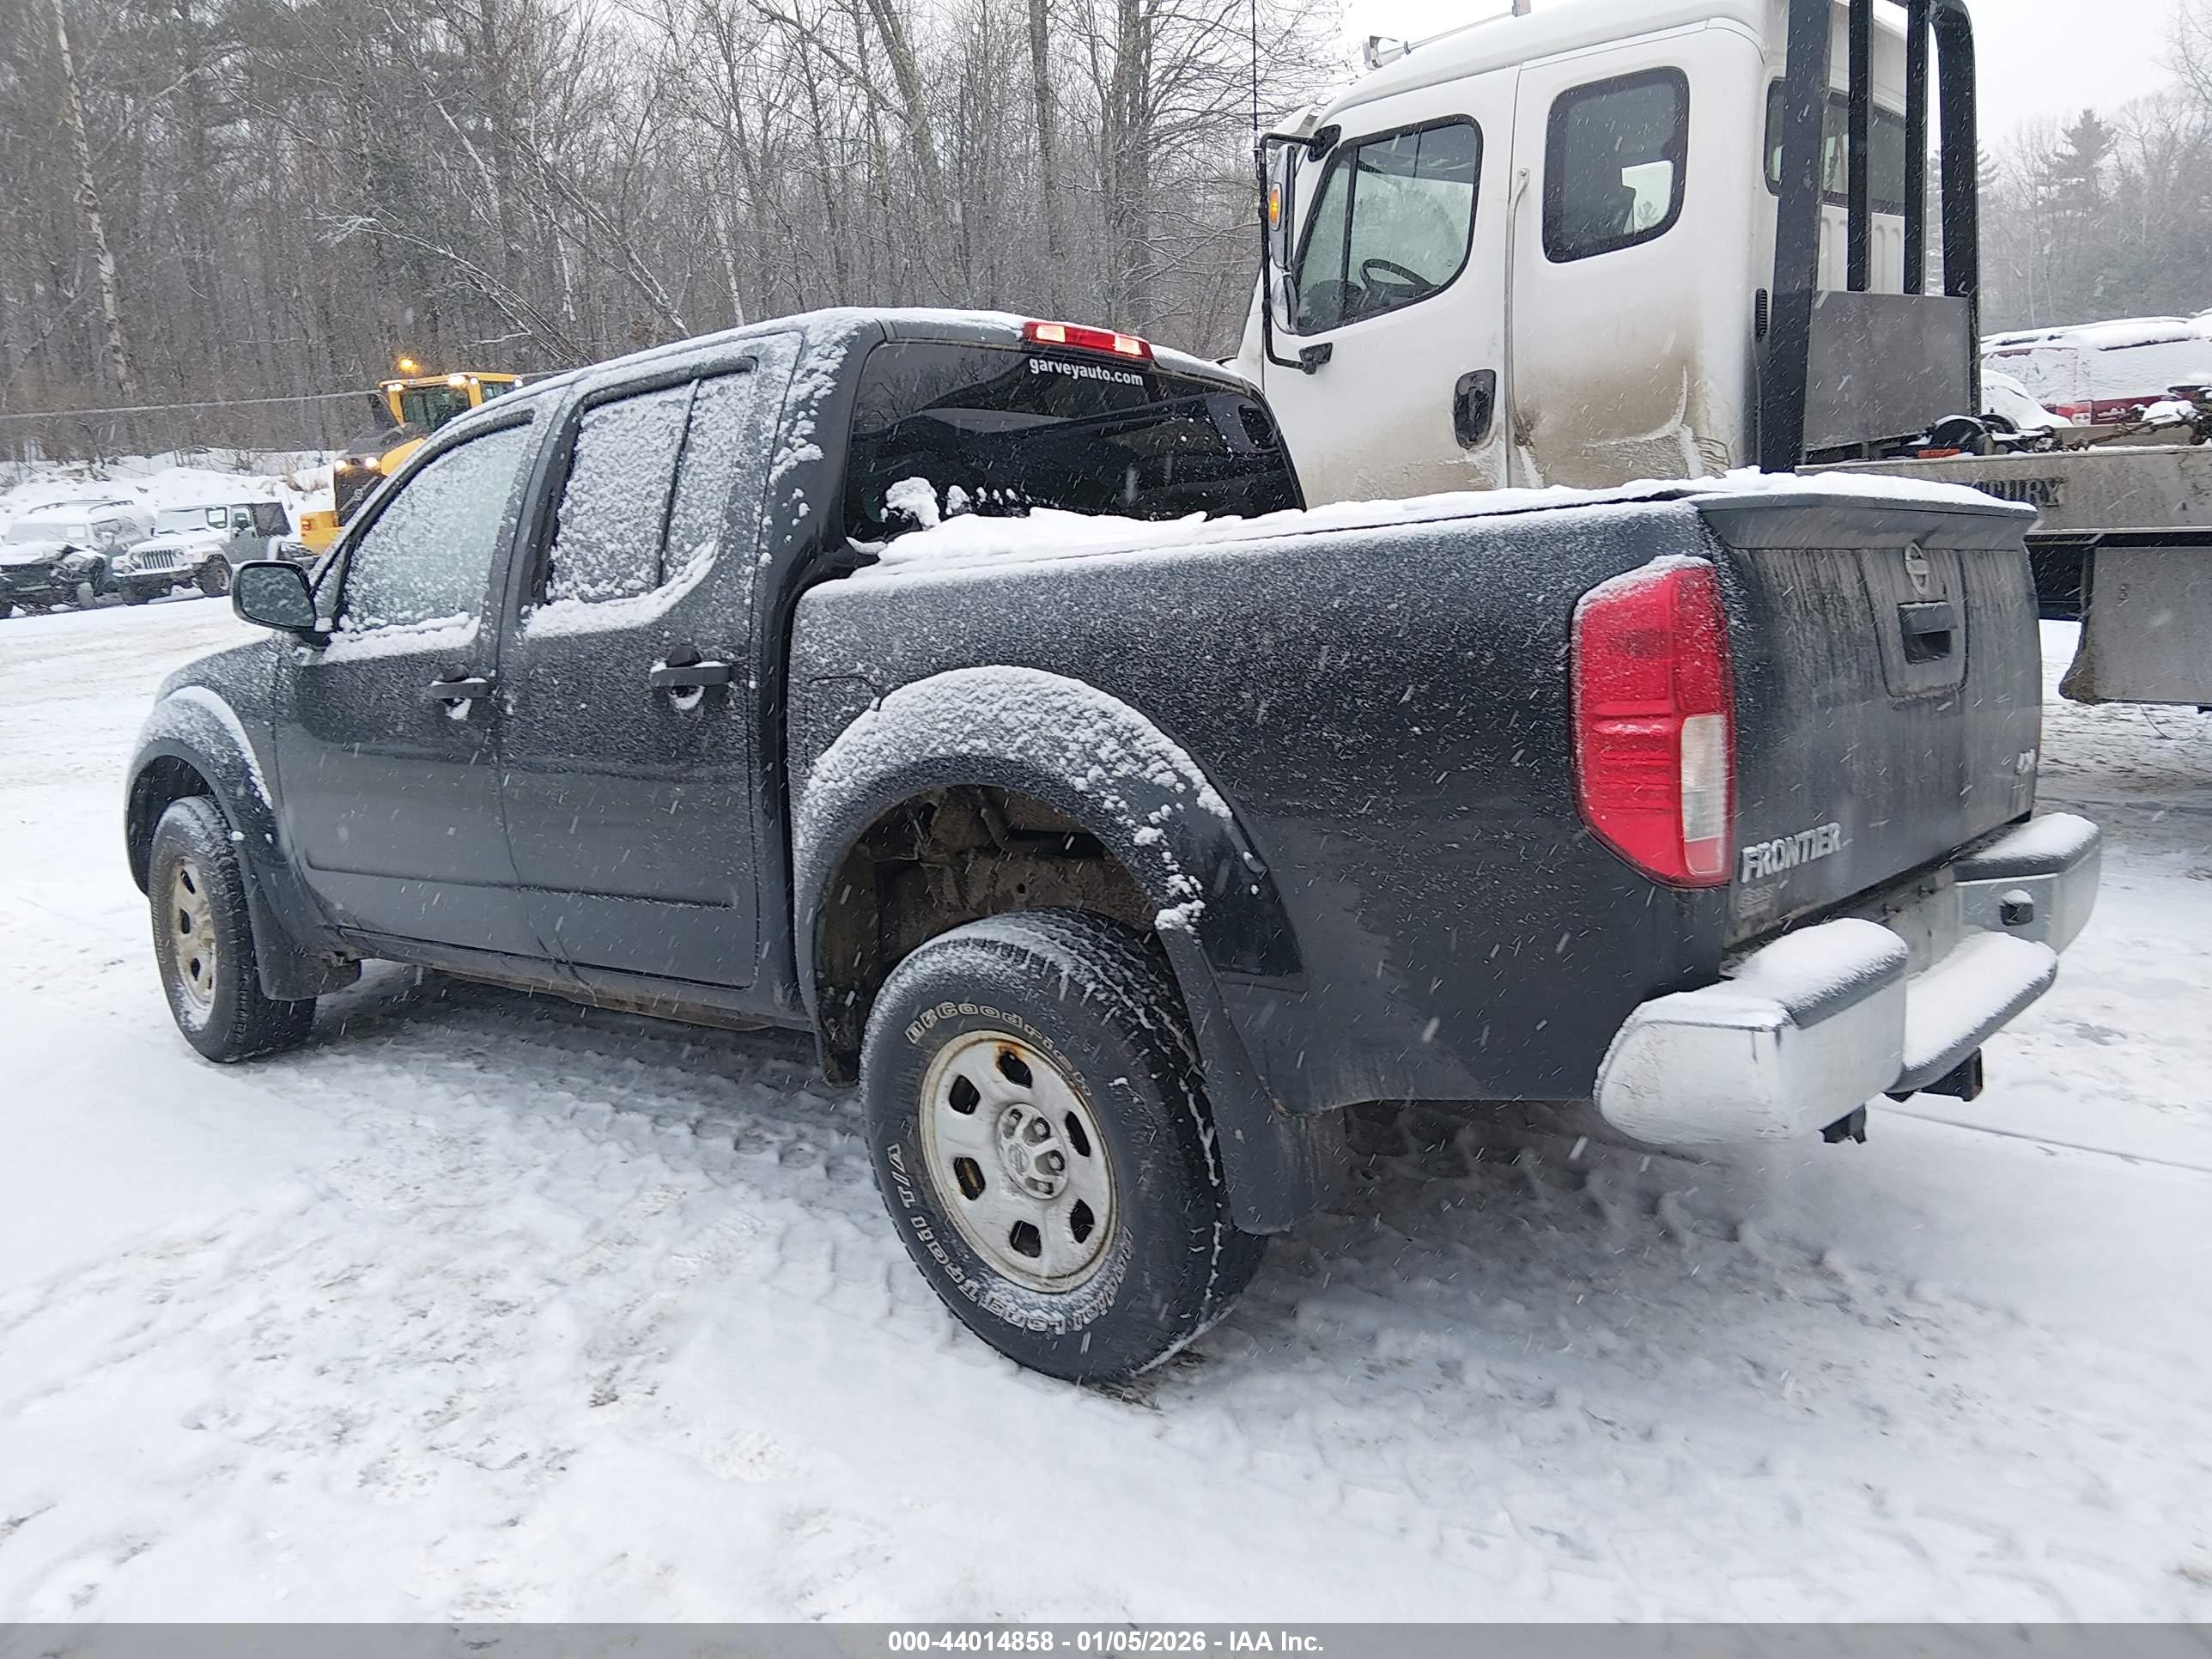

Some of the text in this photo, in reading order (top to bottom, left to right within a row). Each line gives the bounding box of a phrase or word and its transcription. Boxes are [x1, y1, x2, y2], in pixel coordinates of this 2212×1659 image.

[1030, 357, 1143, 386] garveyauto.com
[1740, 822, 1841, 884] FRONTIER
[904, 1001, 1092, 1097] BFGoodrich
[887, 1143, 916, 1209] T/A
[911, 1215, 980, 1304] Trail
